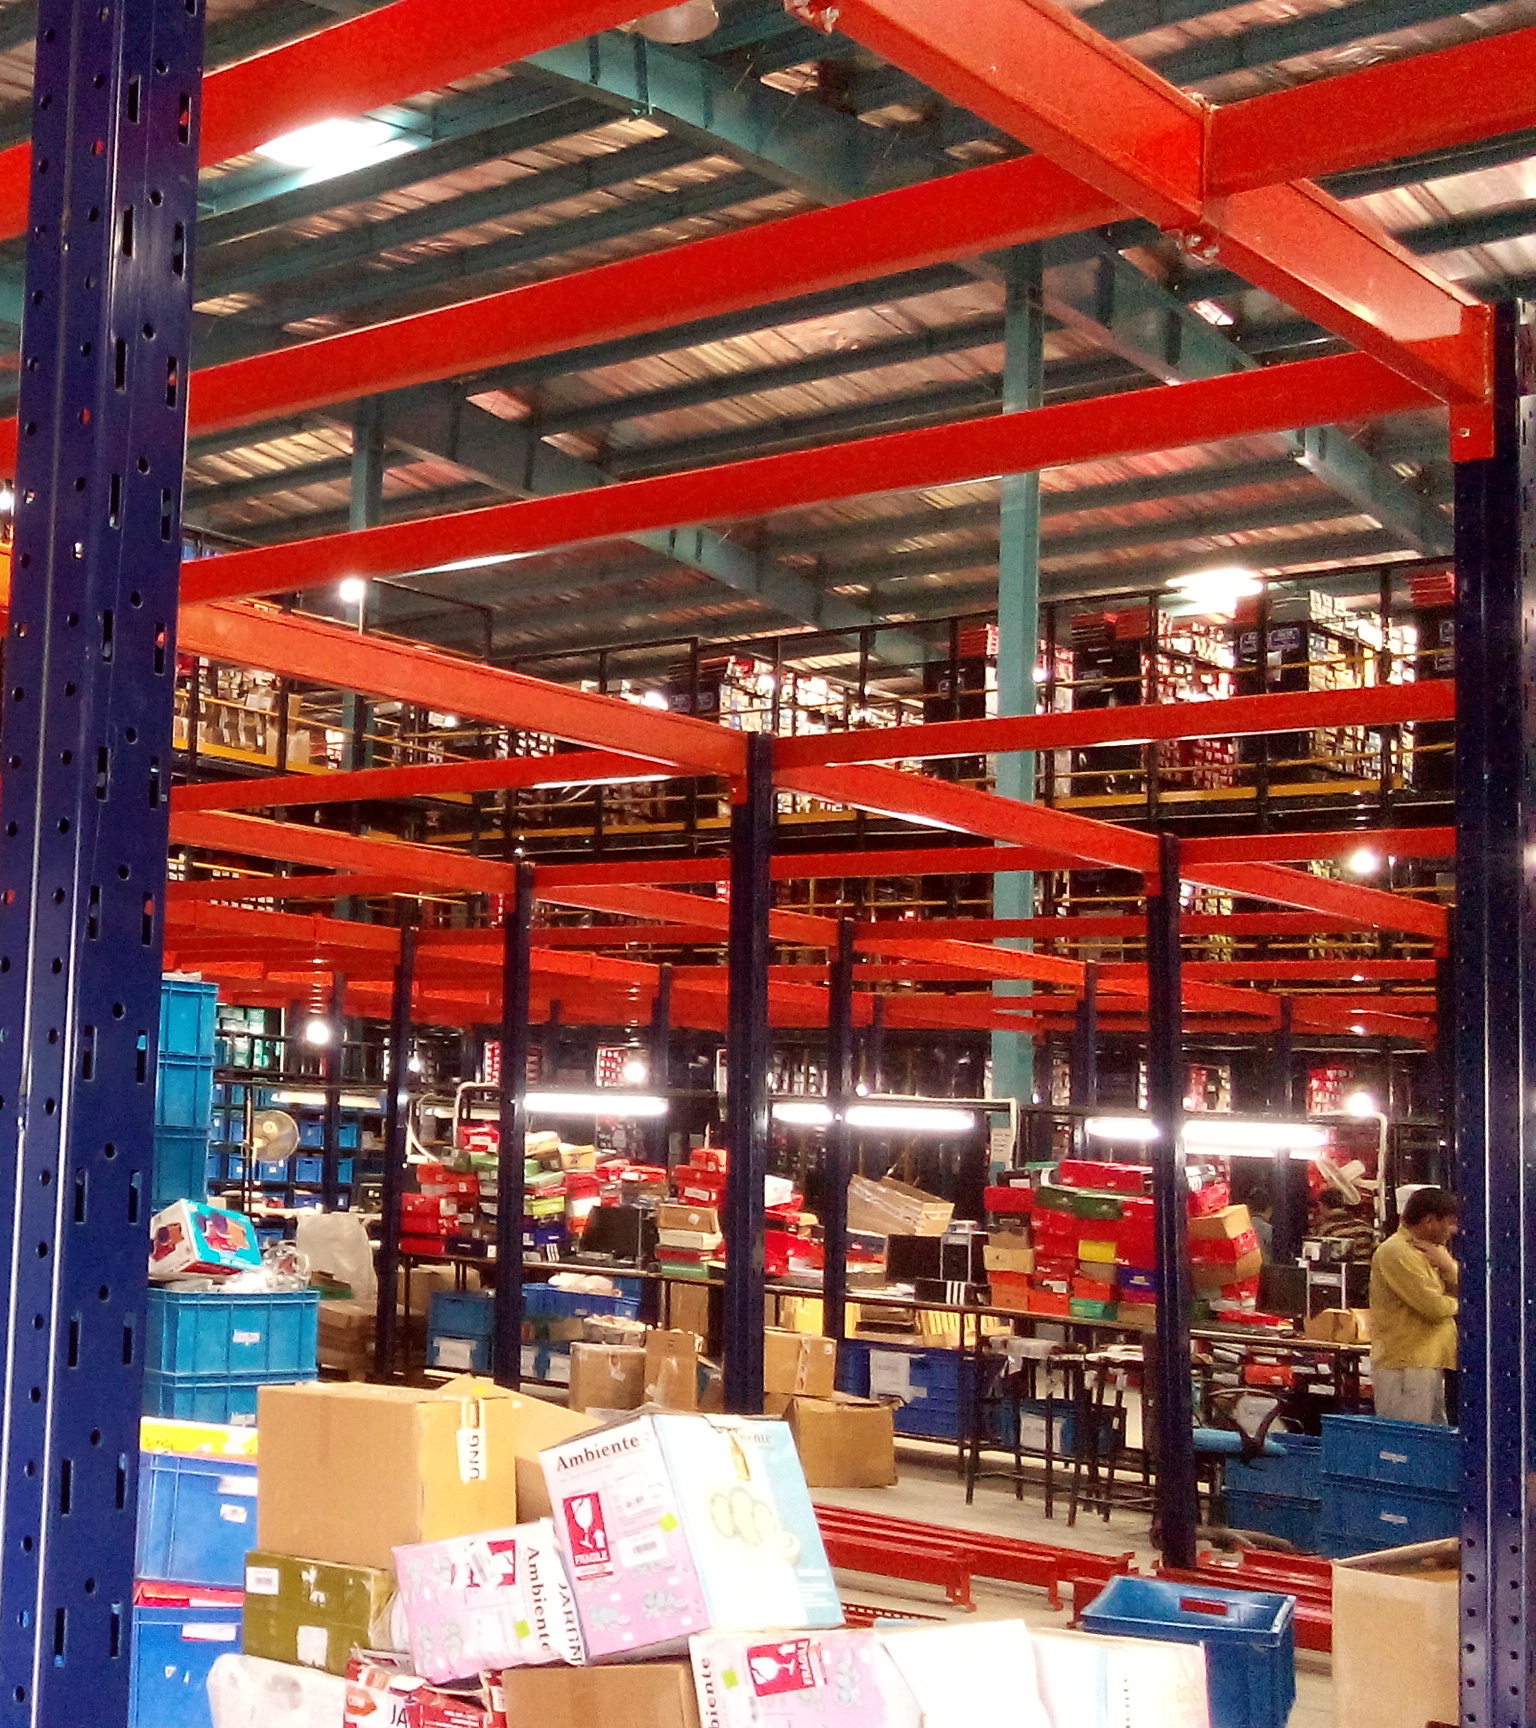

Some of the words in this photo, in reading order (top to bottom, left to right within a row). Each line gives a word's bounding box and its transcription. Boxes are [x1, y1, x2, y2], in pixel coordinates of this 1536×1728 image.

[556, 1435, 641, 1472] Ambiente
[574, 1551, 610, 1566] FRAGILE
[527, 1546, 552, 1653] Ambiente
[797, 1640, 814, 1686] FRAGILE
[700, 1657, 720, 1728] biente
